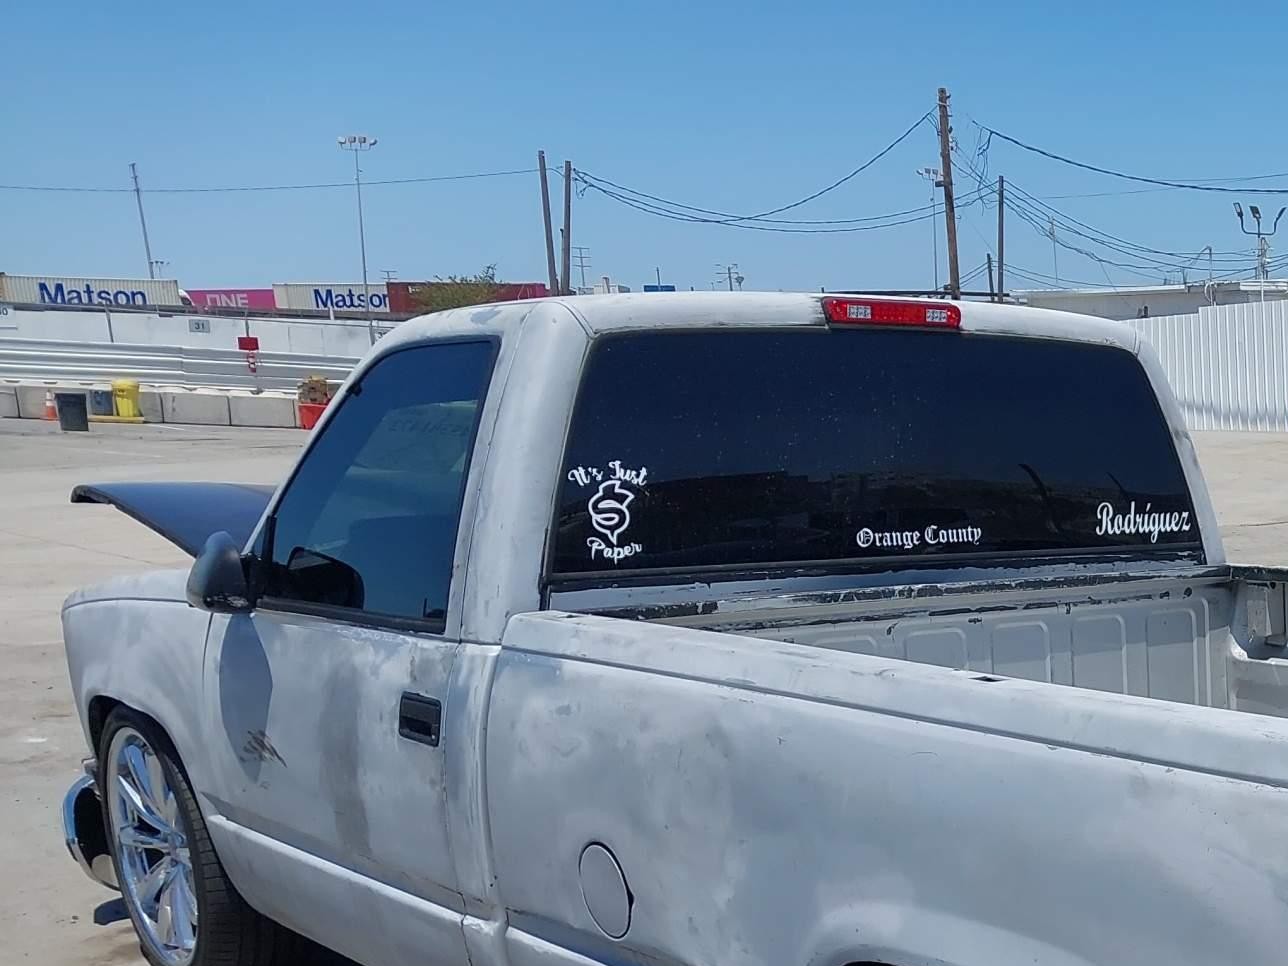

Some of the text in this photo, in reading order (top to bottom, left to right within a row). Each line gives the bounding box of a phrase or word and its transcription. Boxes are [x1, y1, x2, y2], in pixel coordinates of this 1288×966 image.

[38, 282, 147, 305] Matson
[567, 460, 647, 487] It's Just
[856, 525, 982, 549] Orange County
[586, 536, 642, 565] Paper
